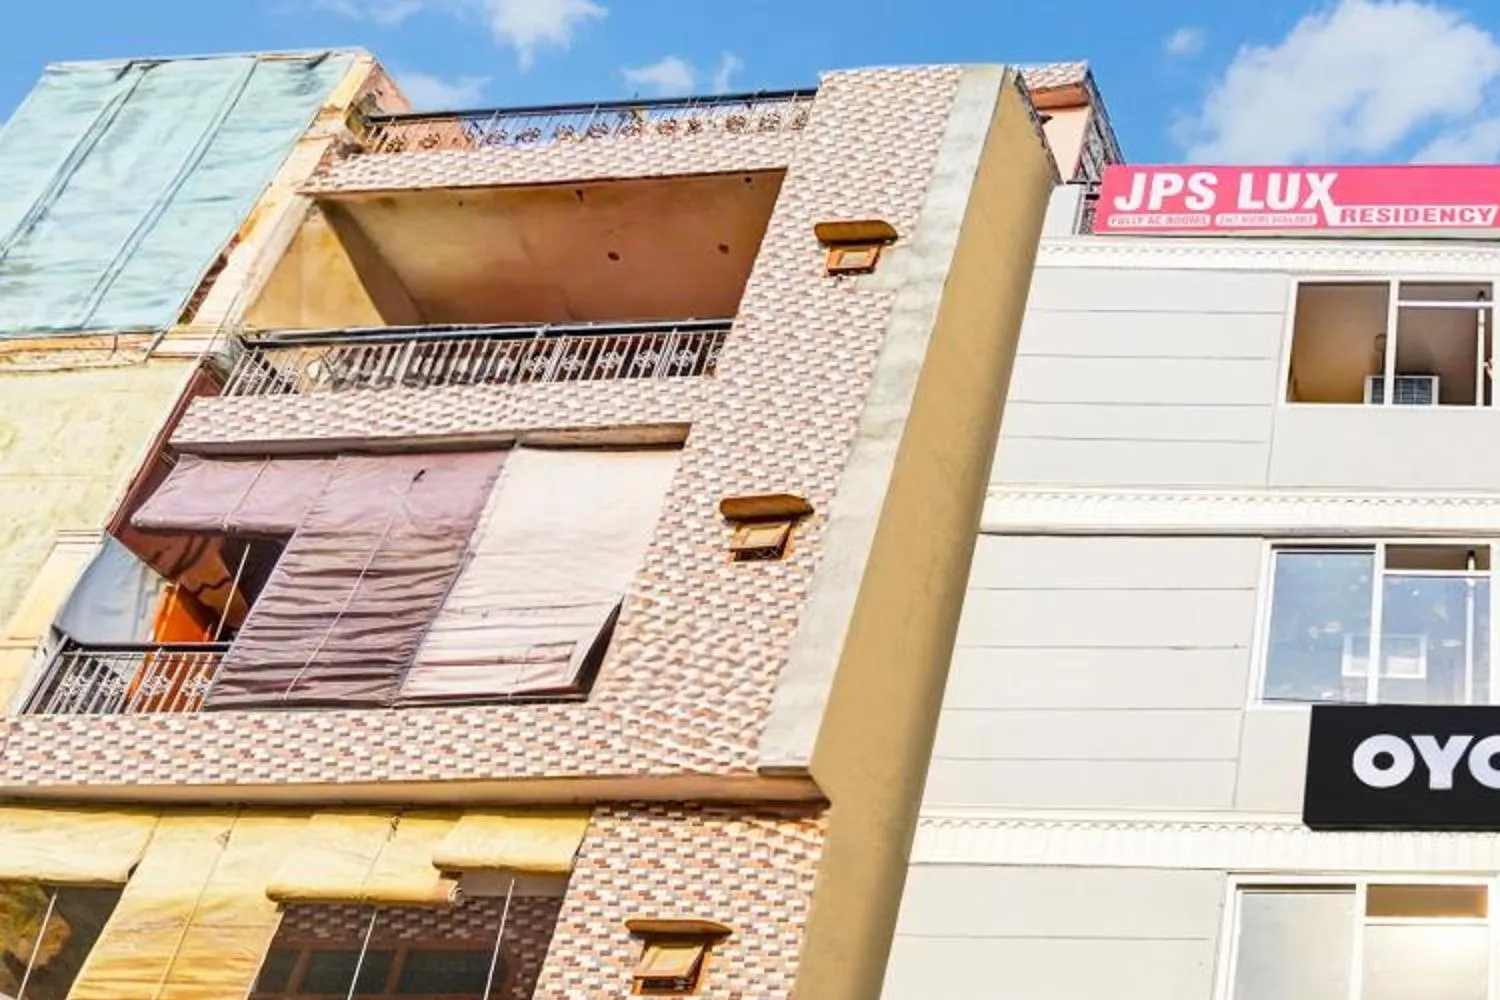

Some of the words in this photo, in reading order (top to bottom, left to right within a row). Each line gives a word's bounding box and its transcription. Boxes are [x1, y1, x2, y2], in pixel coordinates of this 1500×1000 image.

[1114, 172, 1218, 211] JPS
[1236, 172, 1338, 211] LUX
[1339, 206, 1495, 225] RESIDENCY
